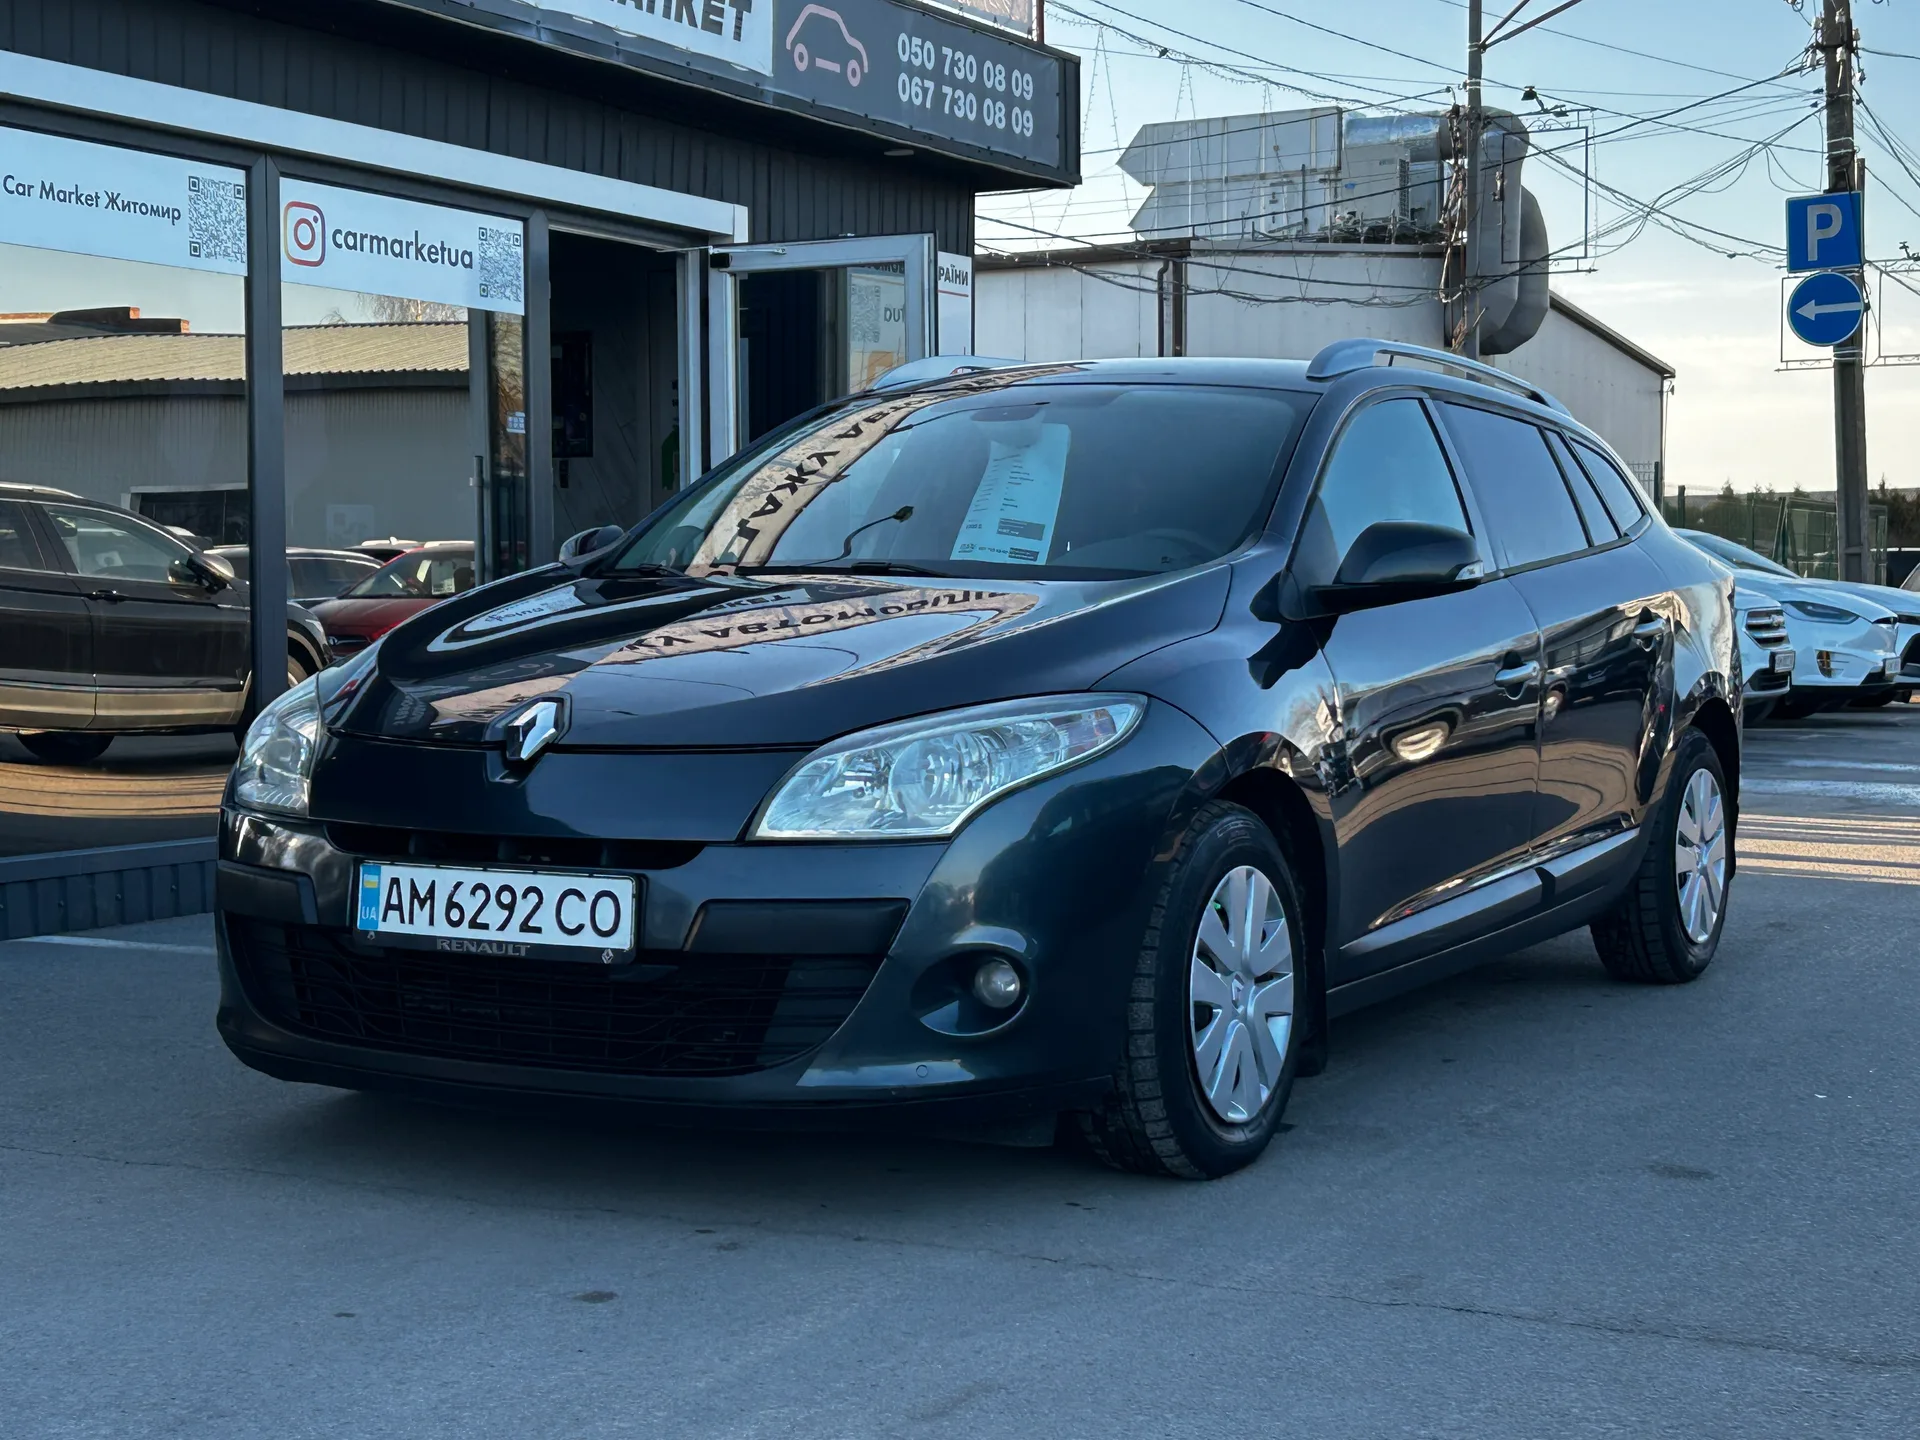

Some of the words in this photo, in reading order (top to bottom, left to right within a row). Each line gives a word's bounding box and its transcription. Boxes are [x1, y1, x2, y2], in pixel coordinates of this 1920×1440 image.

[611, 0, 752, 42] KET
[897, 32, 935, 70] 050
[941, 46, 977, 83] 730
[983, 60, 1006, 92] 08
[1011, 69, 1034, 100] 09
[897, 72, 935, 110] 067
[941, 85, 977, 122] 730
[983, 98, 1006, 129] 08
[1011, 106, 1034, 137] 09
[2, 174, 35, 198] Car
[39, 179, 101, 208] Market
[104, 190, 182, 226] Житомир
[331, 229, 474, 270] carmarketua
[1806, 203, 1843, 262] P
[361, 906, 378, 921] UA
[381, 876, 436, 927] AM
[444, 880, 544, 934] 6292
[555, 887, 621, 938] CO
[436, 938, 531, 957] RENAULT
